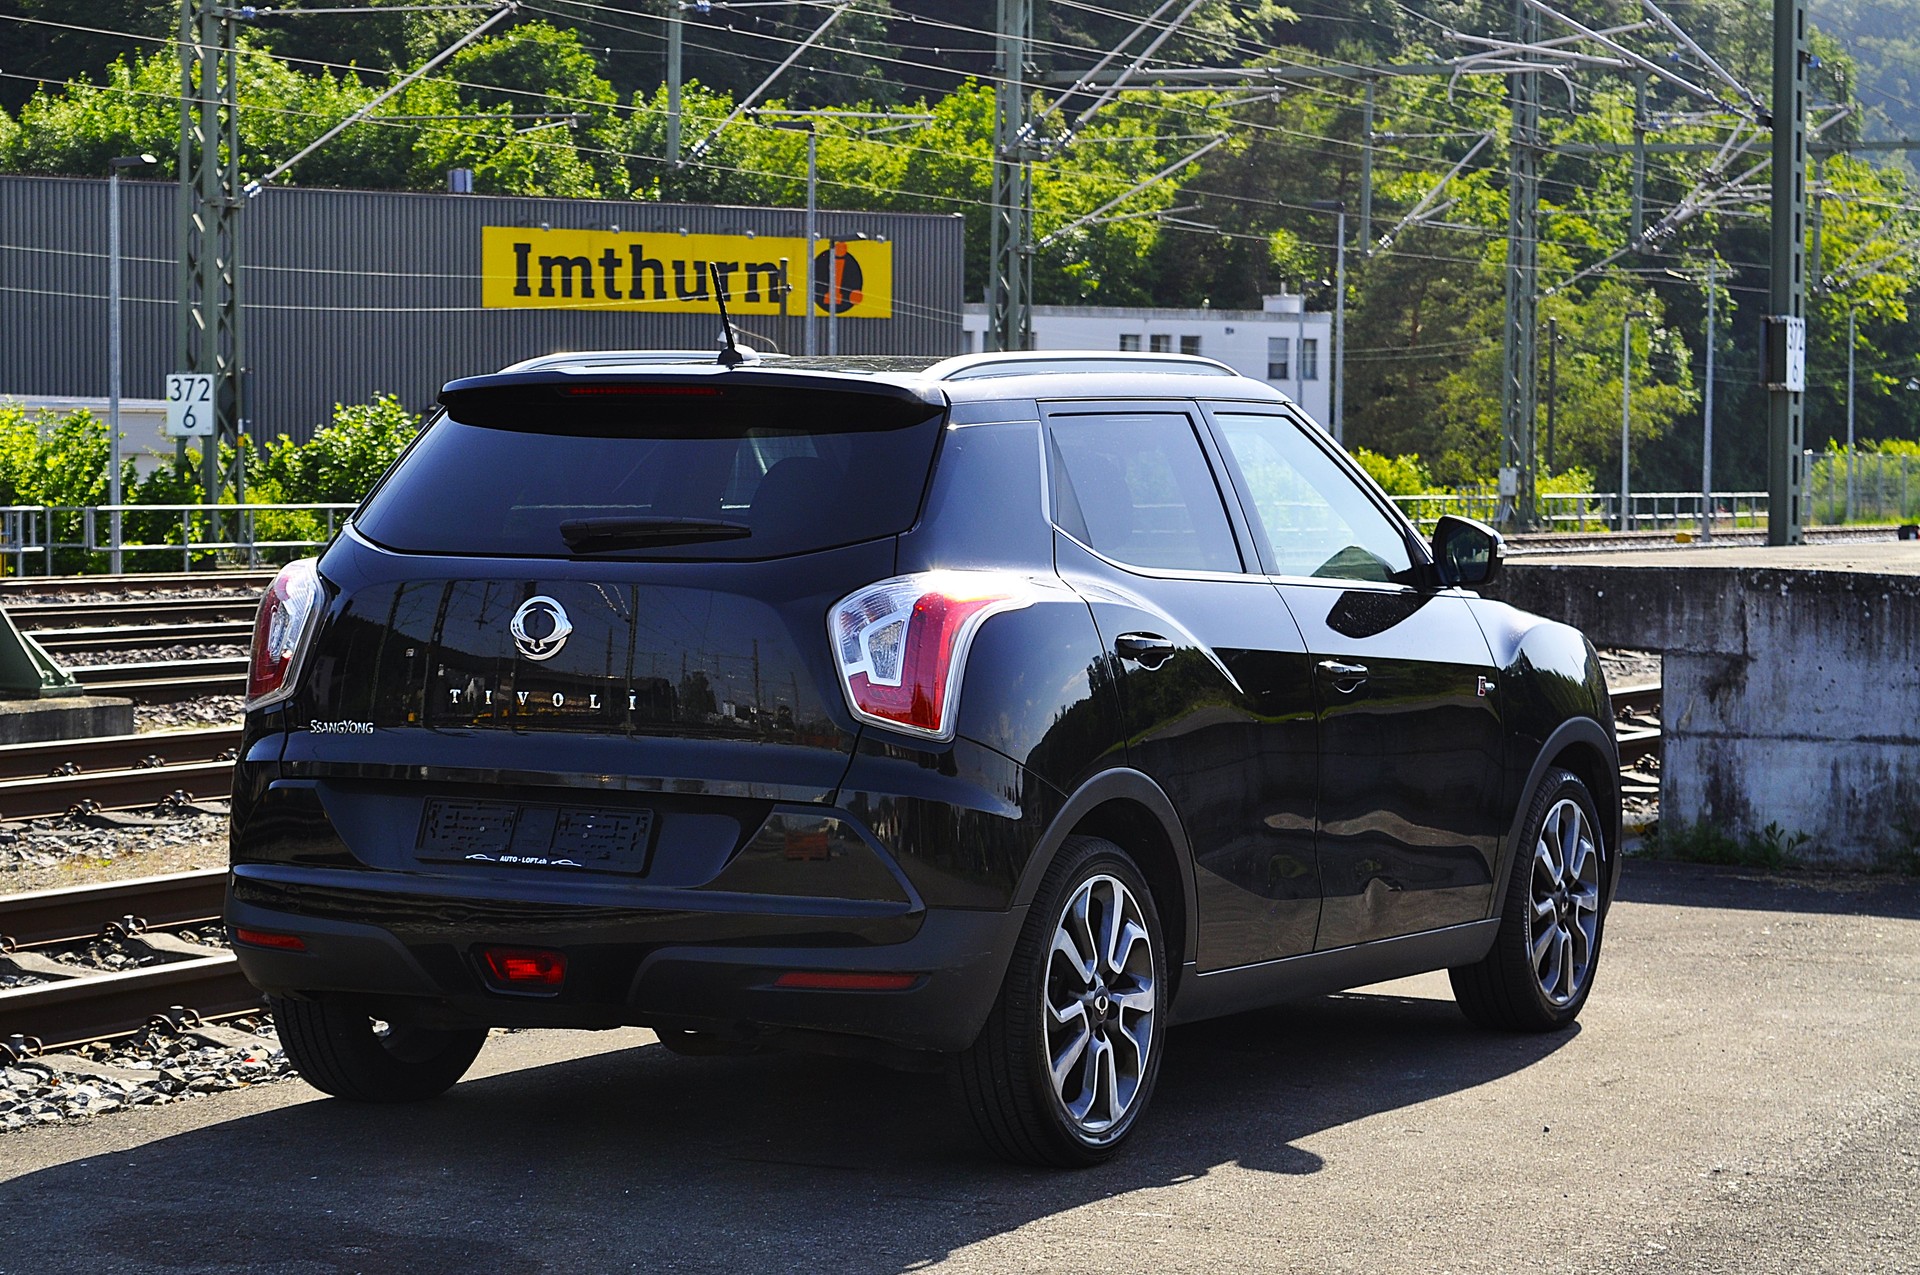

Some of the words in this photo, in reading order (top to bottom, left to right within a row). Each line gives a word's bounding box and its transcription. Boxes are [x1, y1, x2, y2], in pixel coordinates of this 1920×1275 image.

[513, 243, 783, 303] Imthurn
[170, 378, 210, 401] 372
[183, 405, 196, 428] 6
[449, 689, 637, 710] TIVOLI
